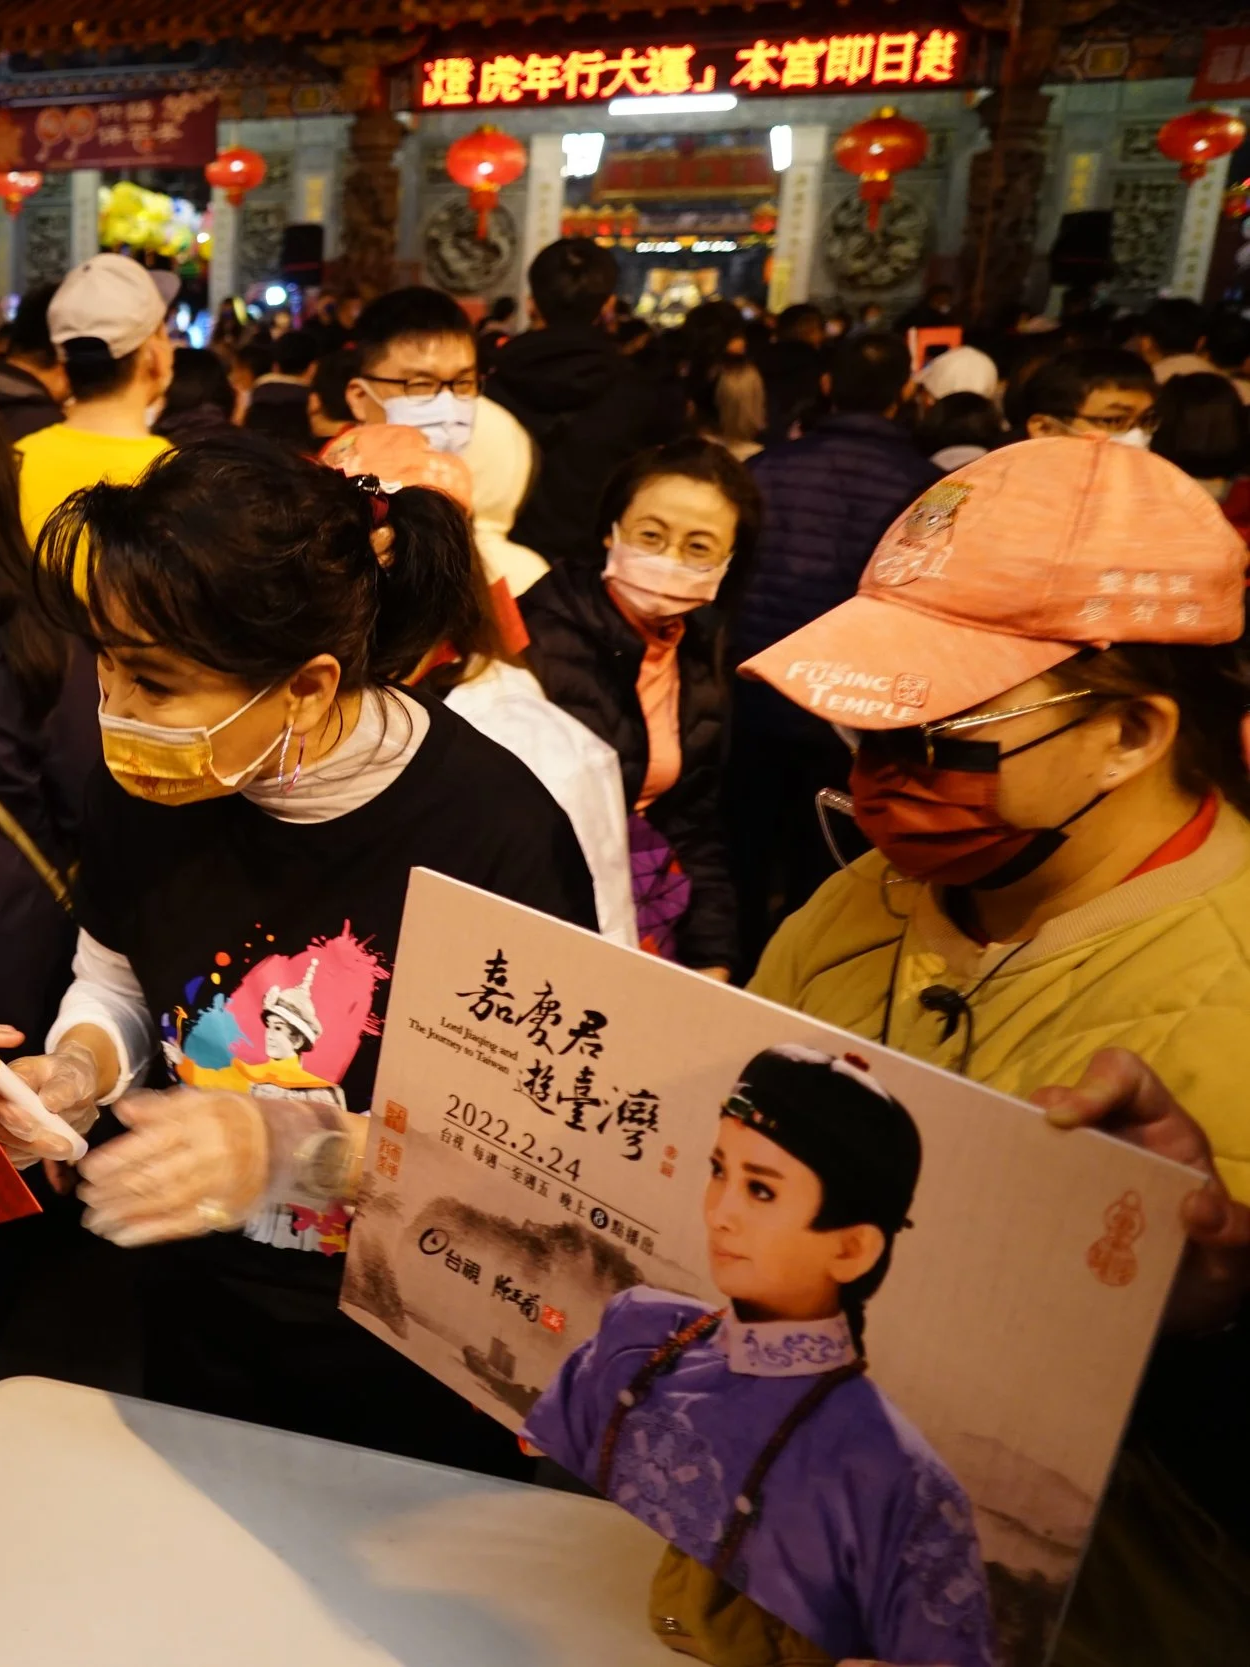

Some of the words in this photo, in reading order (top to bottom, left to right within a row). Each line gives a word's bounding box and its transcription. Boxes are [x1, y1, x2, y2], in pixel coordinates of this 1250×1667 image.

[808, 683, 915, 721] TEMPLE
[455, 948, 608, 1060] 嘉慶君
[409, 1017, 426, 1034] The
[426, 1027, 462, 1054] Journey
[464, 1047, 475, 1057] to
[476, 1049, 510, 1076] Taiwan
[440, 1016, 463, 1035] Lord
[463, 1027, 498, 1054] Jiaqing
[499, 1047, 519, 1062] and
[440, 1127, 465, 1152] 台視
[445, 1094, 581, 1182] 2022.2.24
[445, 1249, 481, 1285] 台視
